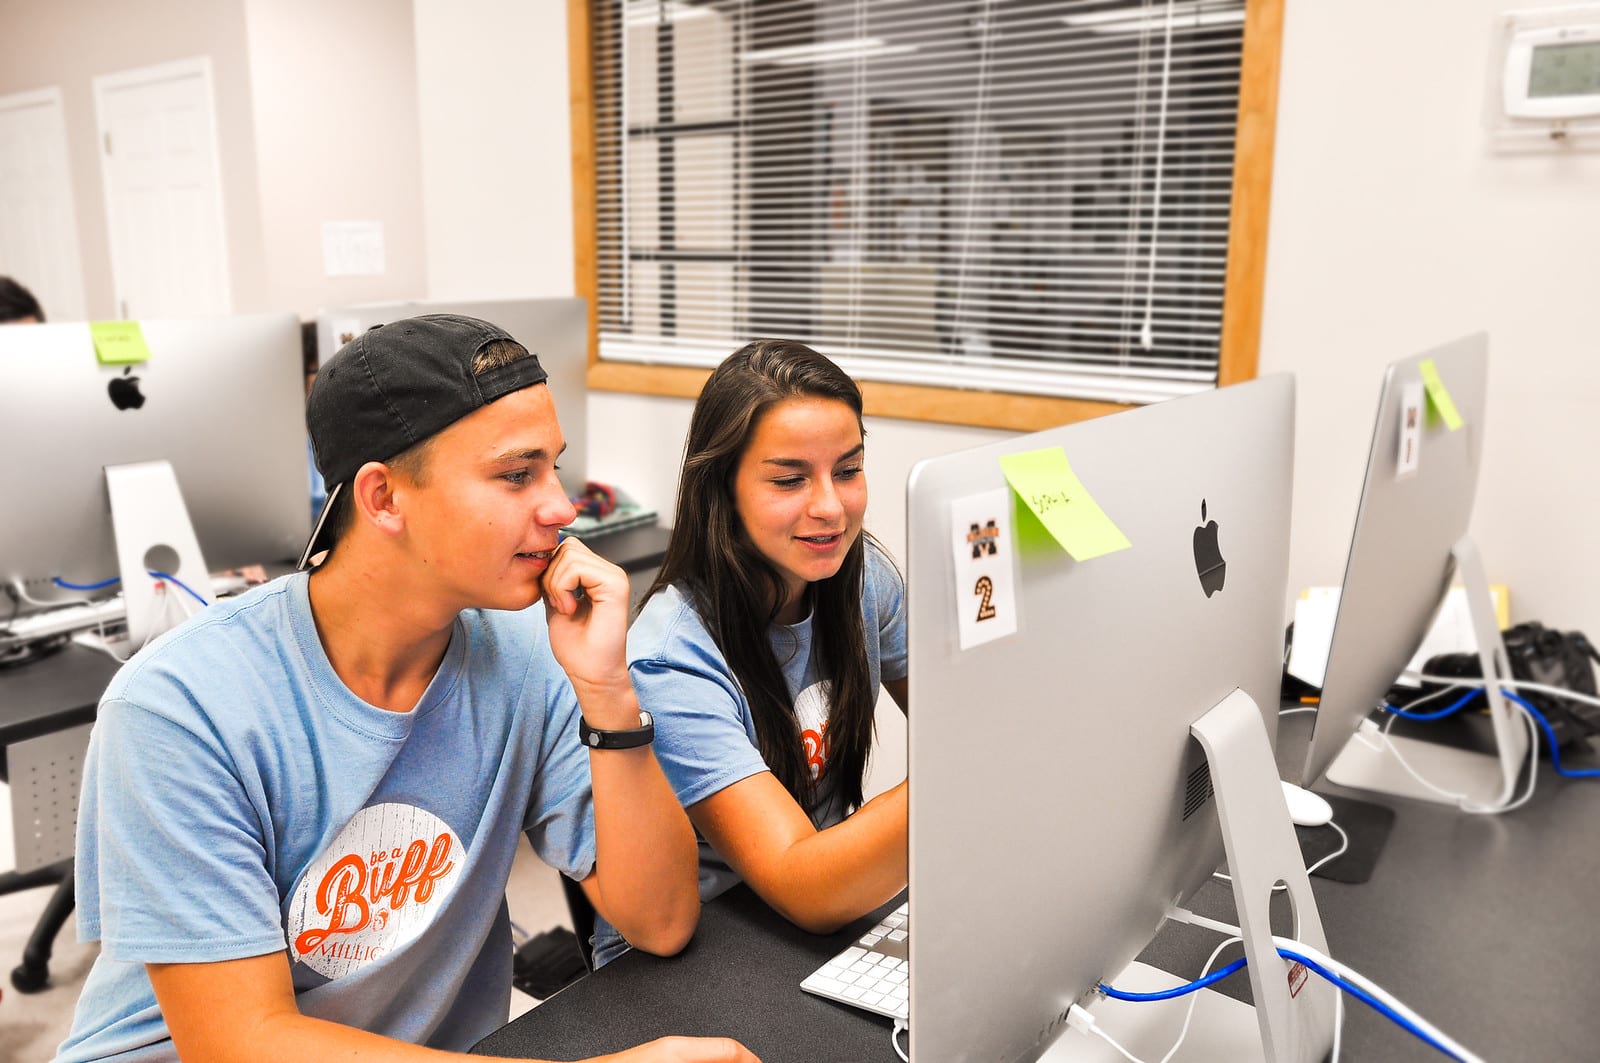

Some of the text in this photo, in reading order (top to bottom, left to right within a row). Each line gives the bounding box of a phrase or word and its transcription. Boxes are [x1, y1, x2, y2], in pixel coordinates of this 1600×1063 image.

[974, 576, 996, 622] 2
[370, 847, 403, 865] be a
[295, 833, 454, 955] Buff
